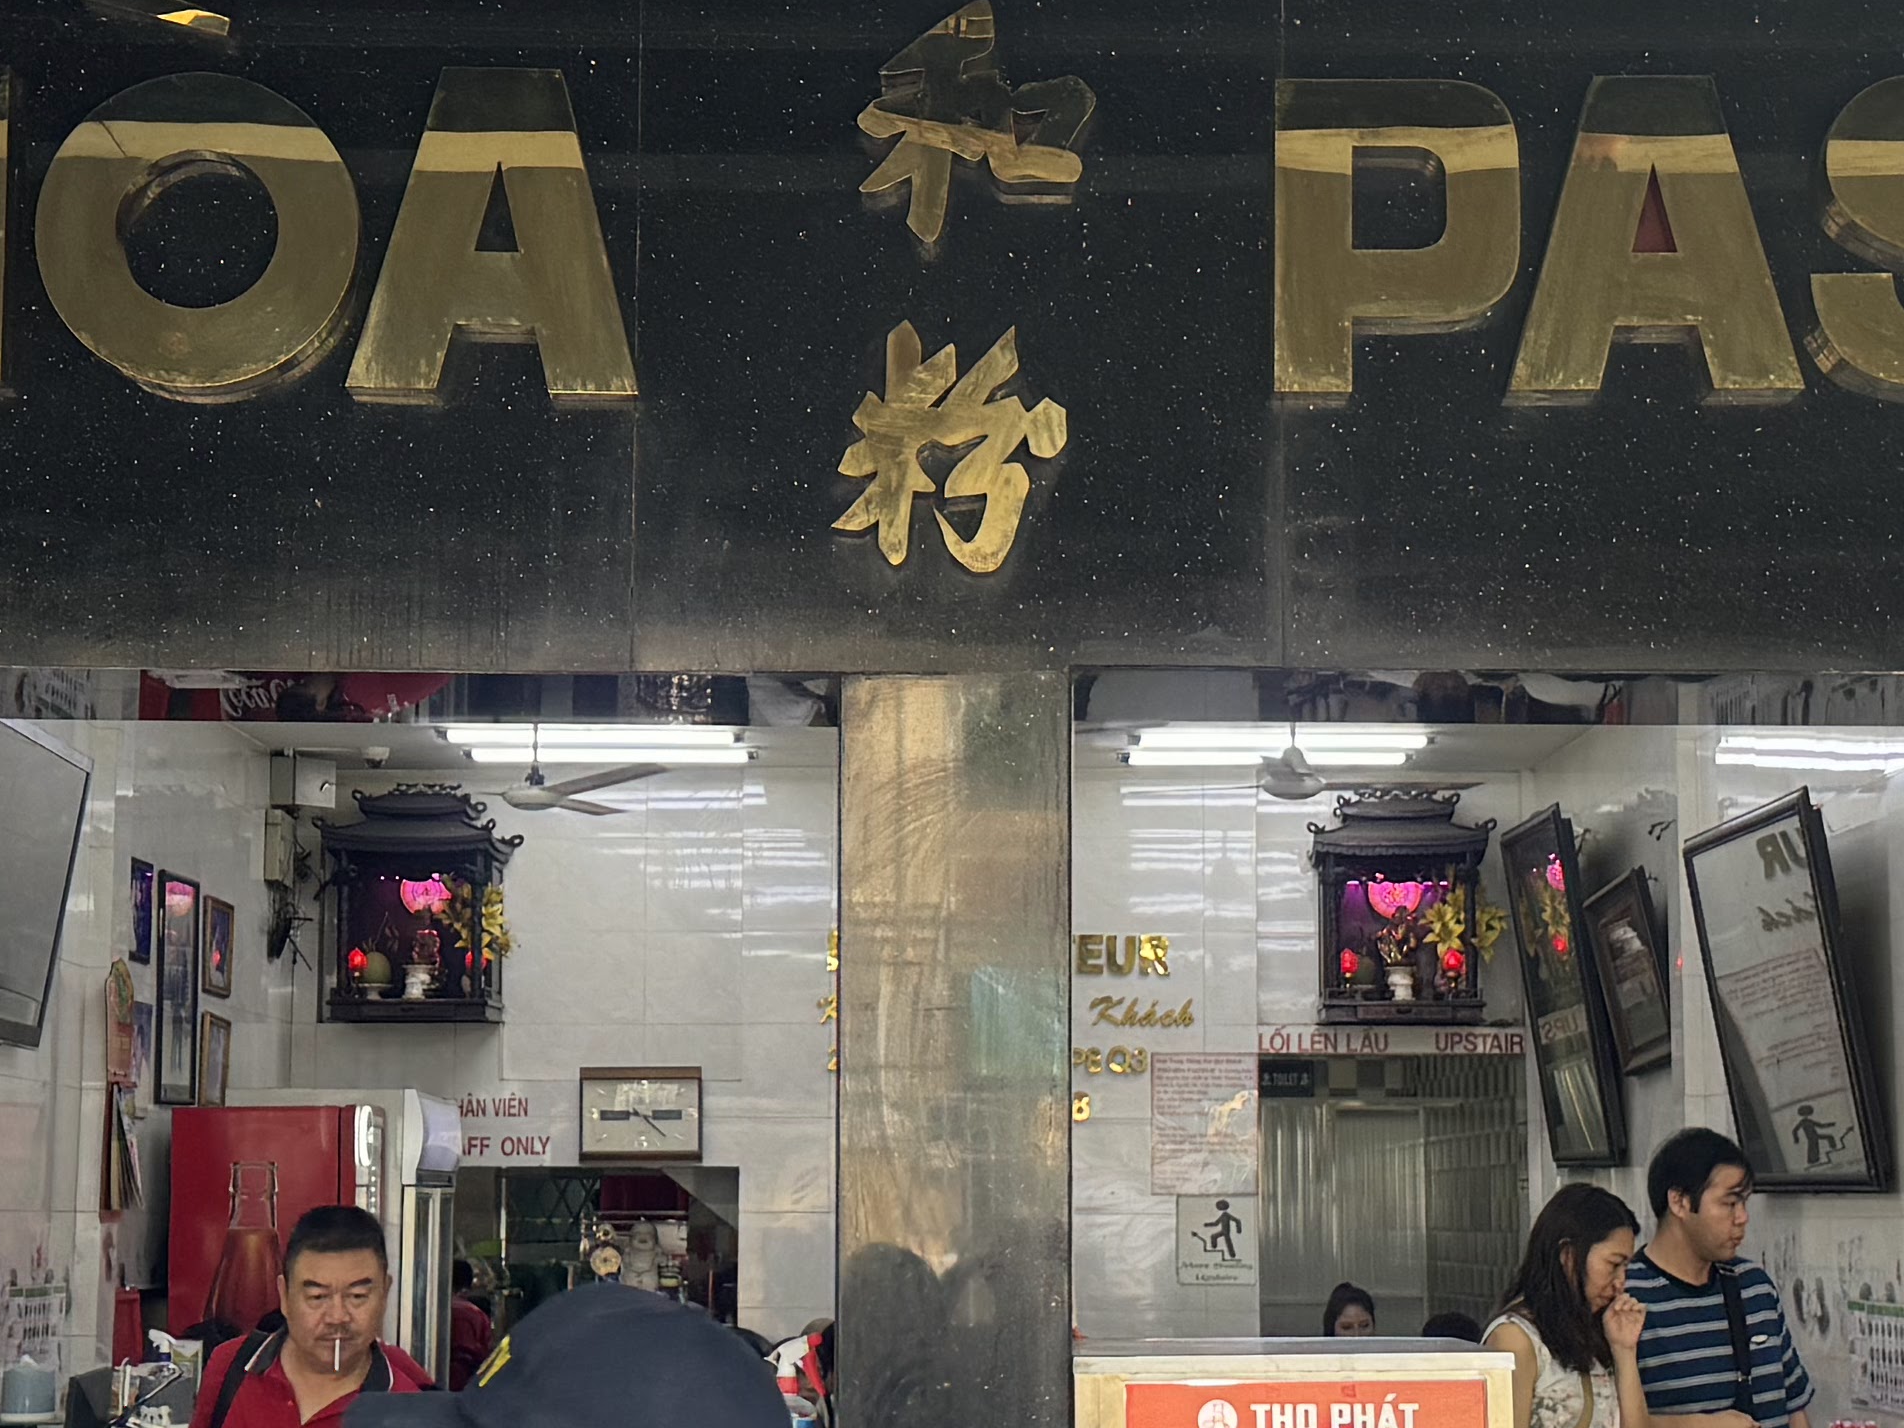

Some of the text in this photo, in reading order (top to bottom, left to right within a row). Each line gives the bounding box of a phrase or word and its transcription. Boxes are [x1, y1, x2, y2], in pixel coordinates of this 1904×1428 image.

[1089, 995, 1195, 1028] Khách
[1434, 1032, 1525, 1054] UPSTAIR
[493, 1092, 528, 1118] VIÊN
[501, 1135, 551, 1156] ONLY
